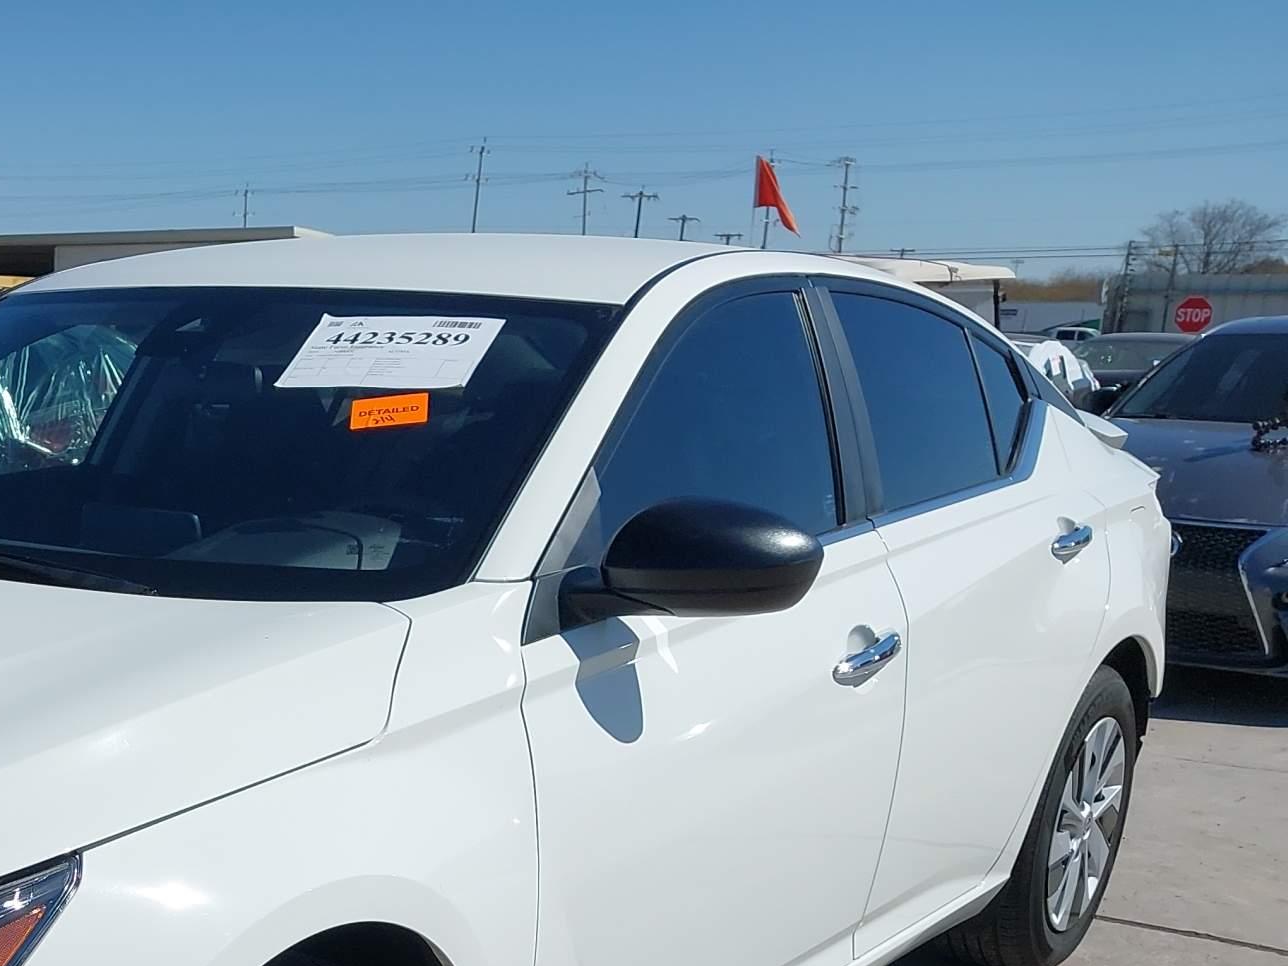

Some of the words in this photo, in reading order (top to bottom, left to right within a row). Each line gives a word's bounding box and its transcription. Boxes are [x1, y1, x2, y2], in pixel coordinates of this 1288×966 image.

[1175, 308, 1211, 323] STOP
[325, 331, 471, 347] 44235289
[358, 405, 420, 417] DETAILED
